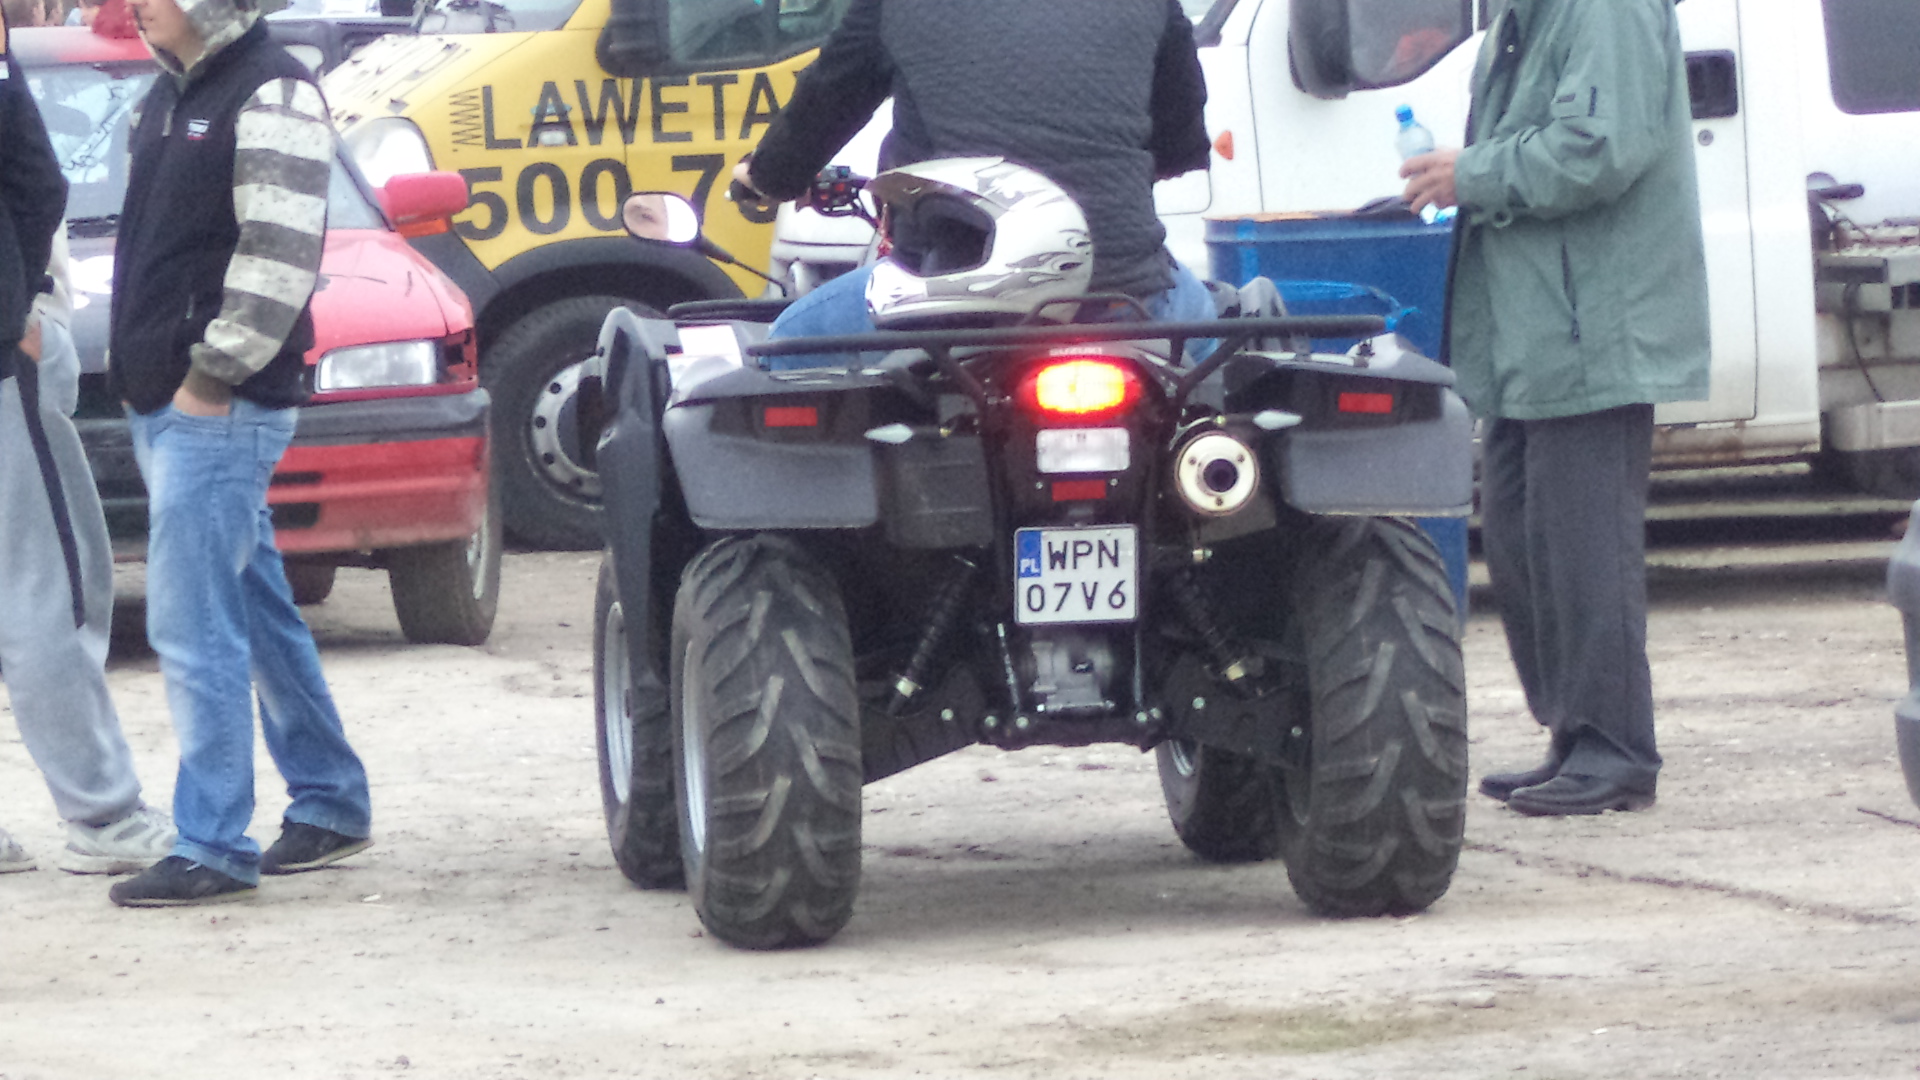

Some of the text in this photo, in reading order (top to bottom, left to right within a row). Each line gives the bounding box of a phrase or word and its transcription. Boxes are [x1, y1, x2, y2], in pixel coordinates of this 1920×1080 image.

[482, 71, 804, 150] LAWETA
[453, 158, 633, 241] 500
[1020, 540, 1120, 574] PL WPN
[1026, 580, 1126, 612] 07V6
